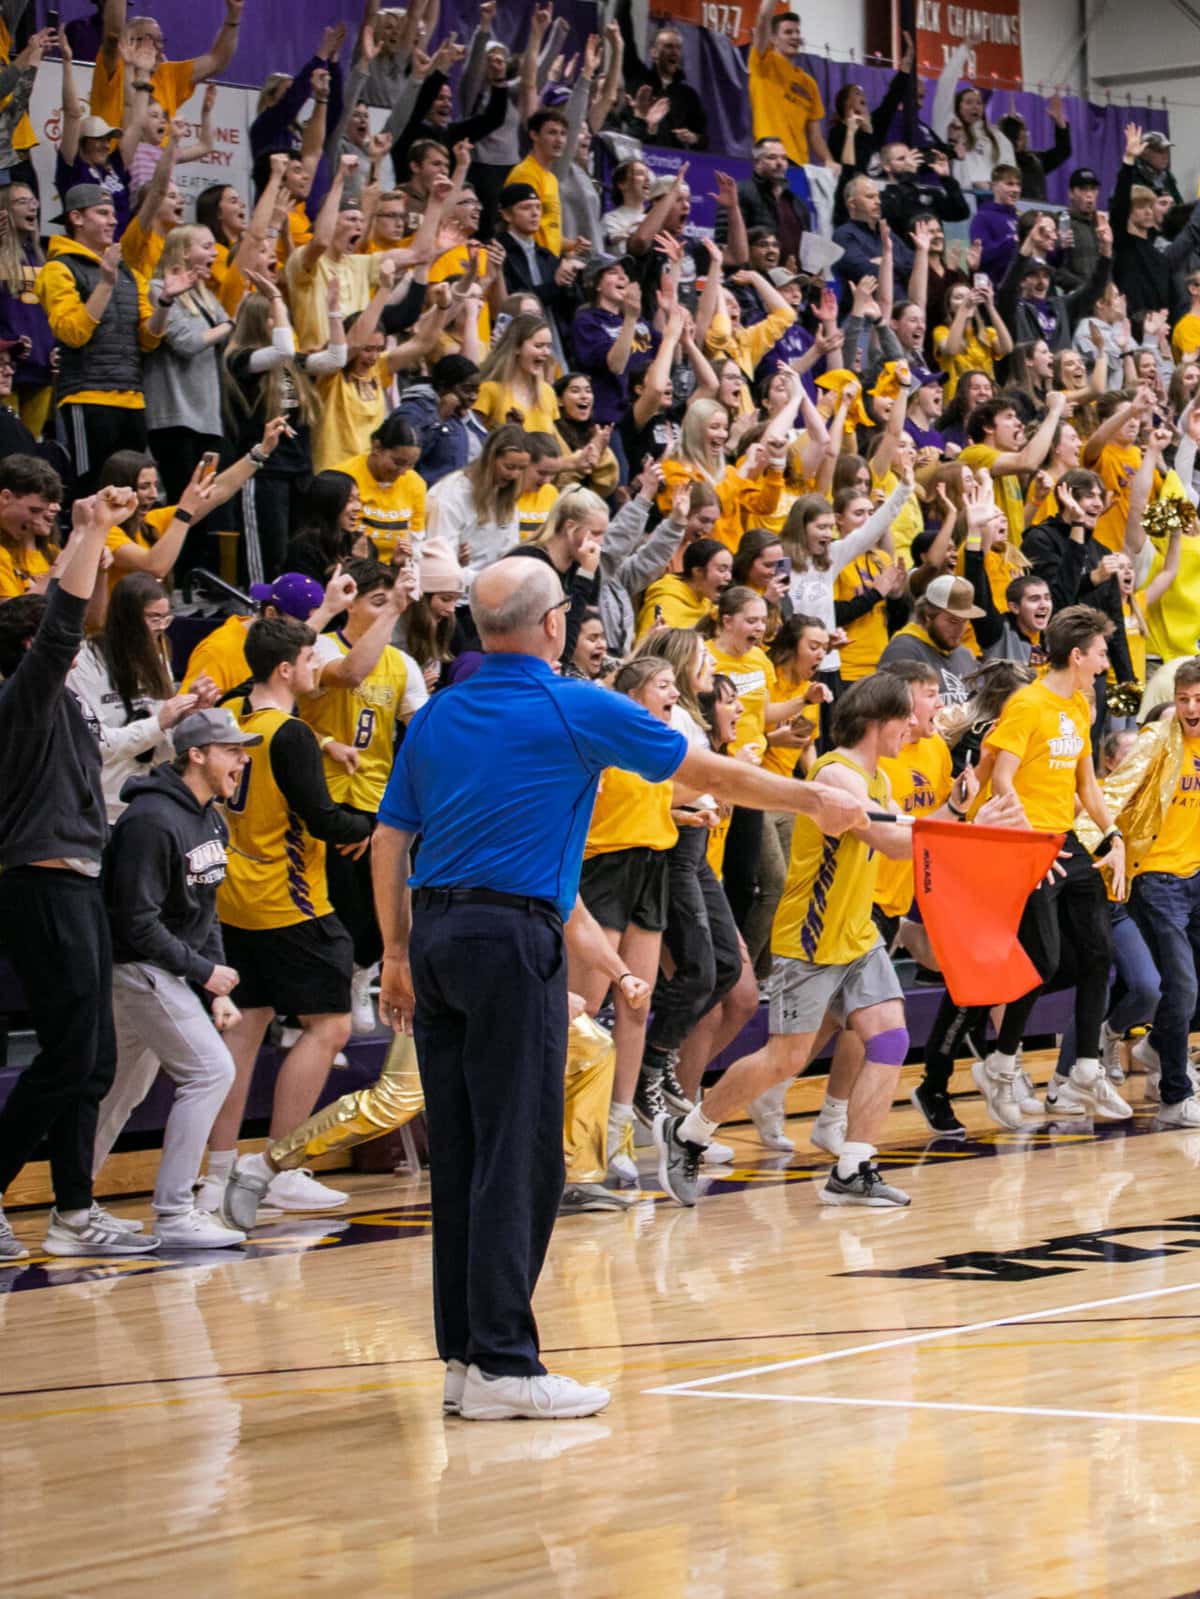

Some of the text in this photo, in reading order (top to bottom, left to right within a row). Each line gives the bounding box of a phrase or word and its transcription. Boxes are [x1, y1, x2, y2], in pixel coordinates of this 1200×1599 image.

[702, 3, 743, 38] 1977
[917, 0, 1020, 45] ACK CHAMPIONS
[354, 707, 375, 749] 8
